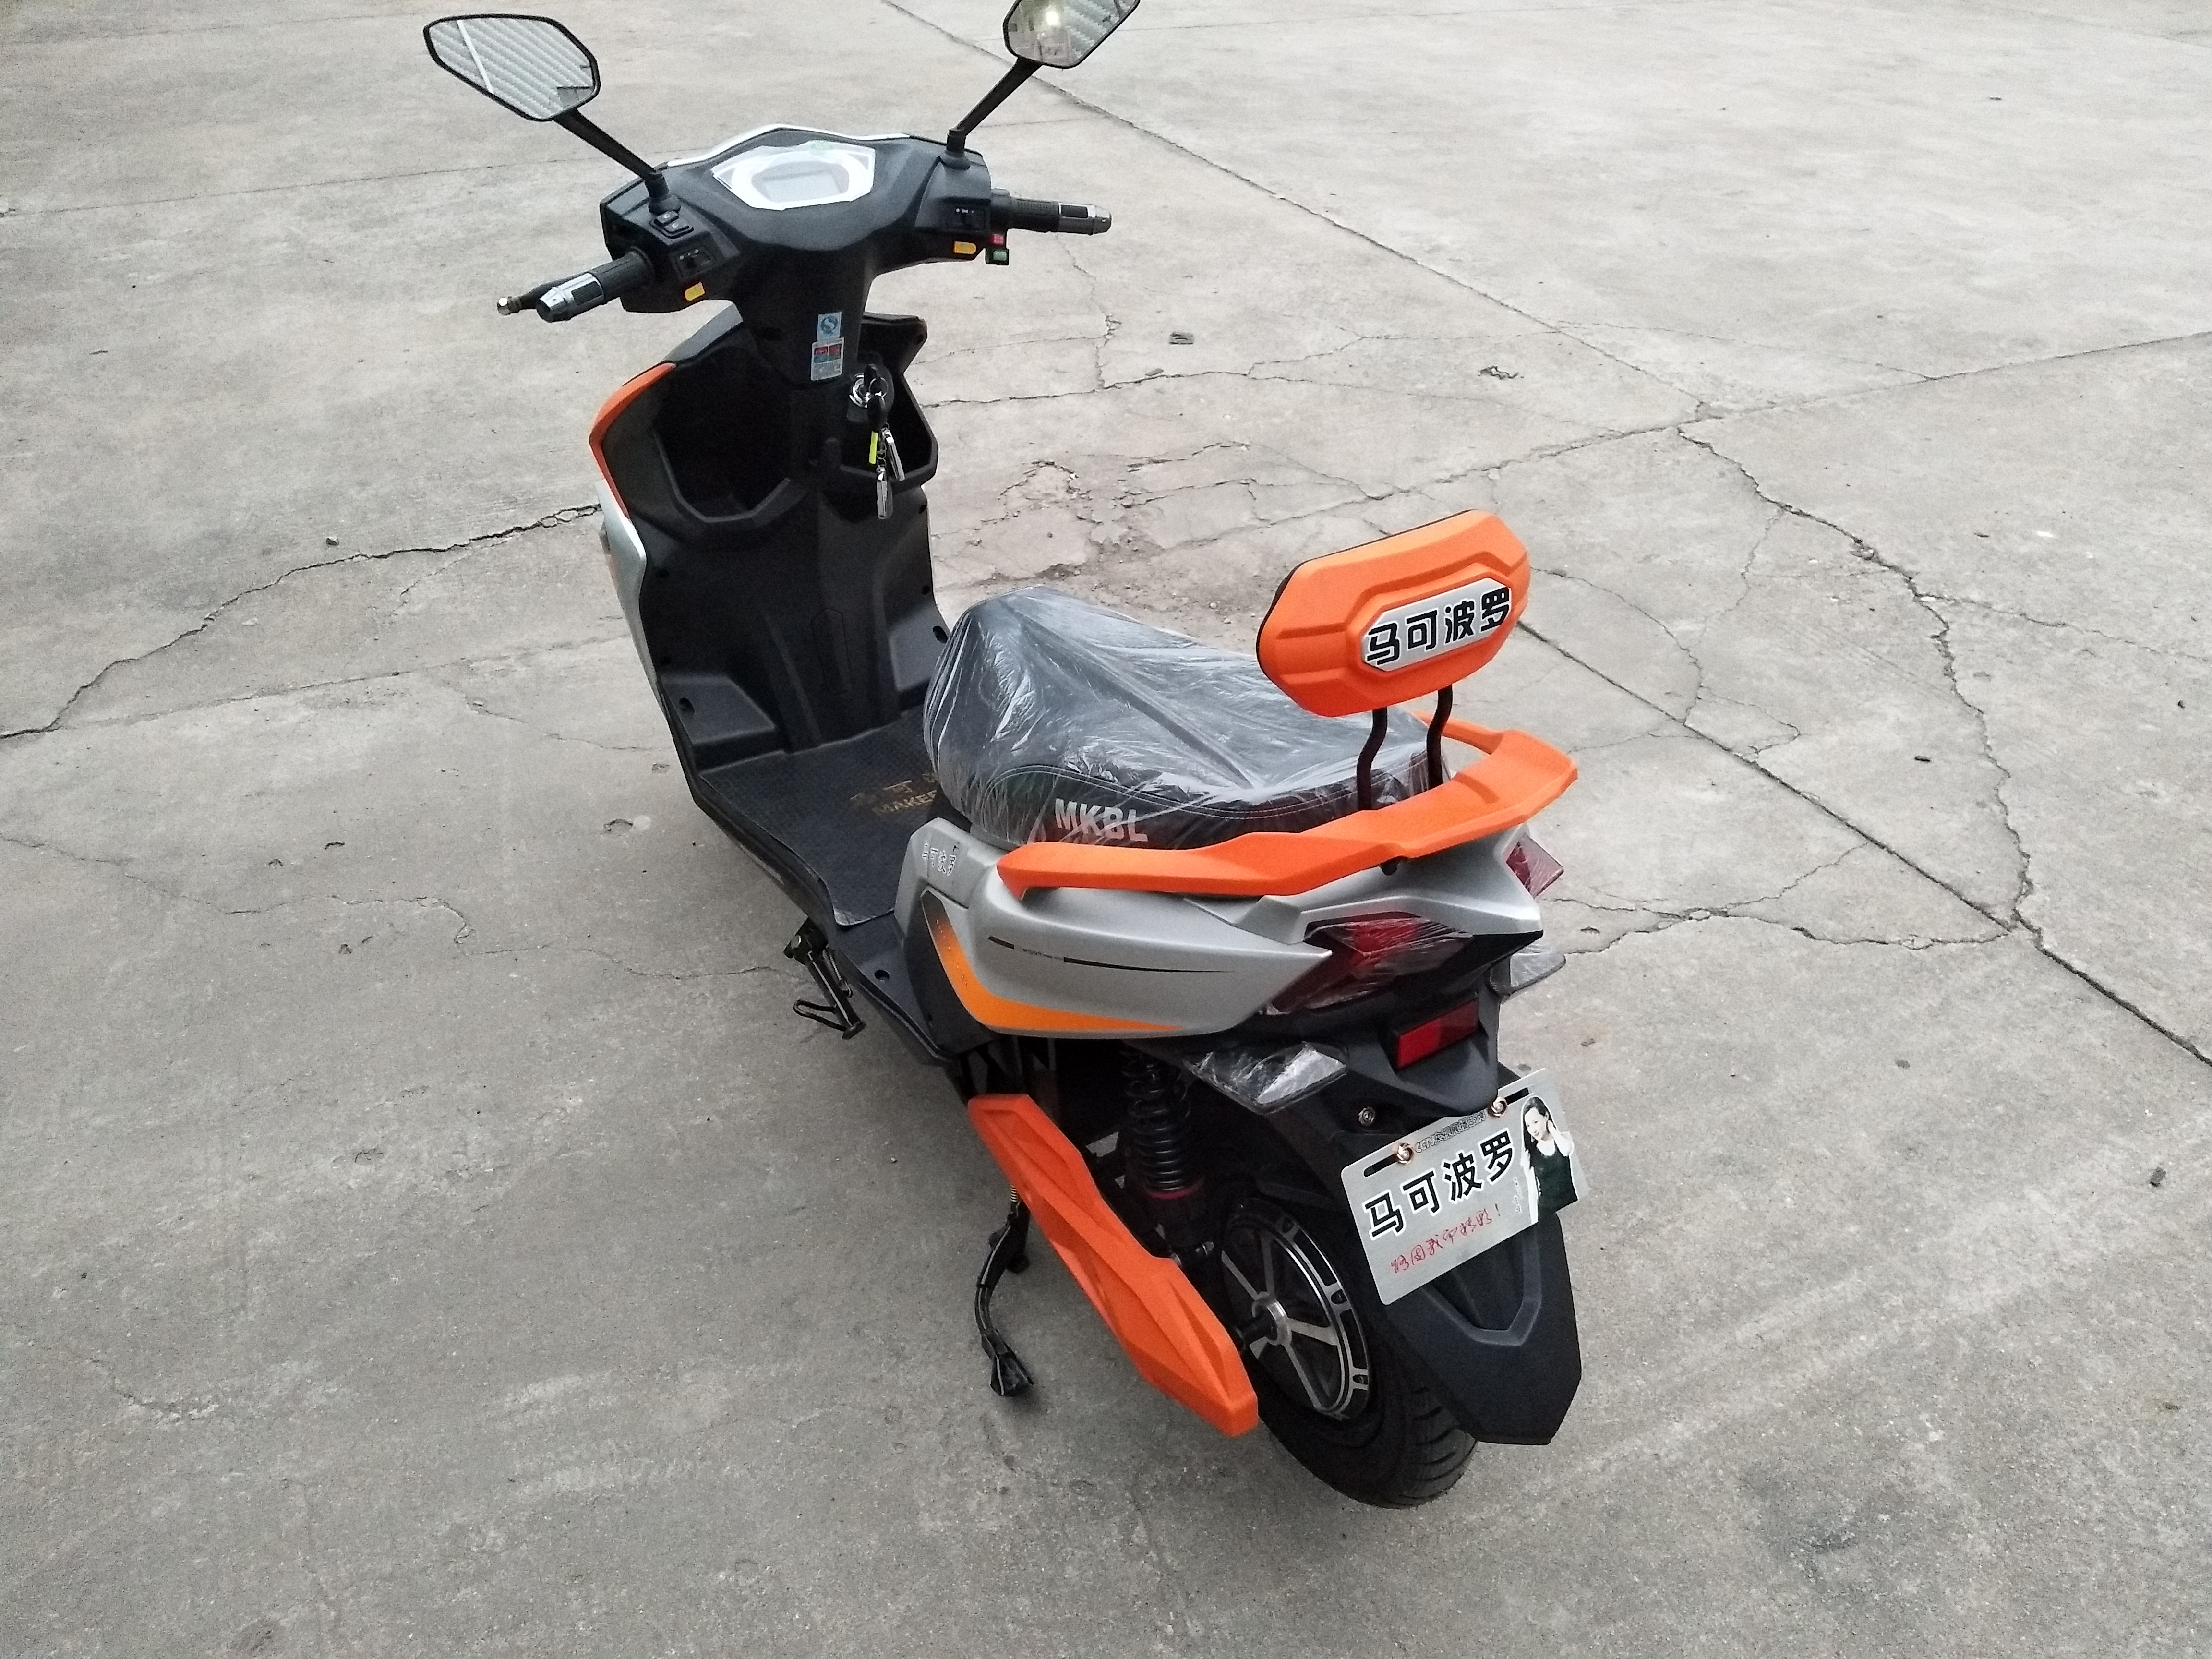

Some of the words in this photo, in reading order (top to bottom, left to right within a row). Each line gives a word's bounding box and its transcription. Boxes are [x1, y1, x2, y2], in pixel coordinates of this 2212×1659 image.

[1366, 587, 1509, 665] 马可波罗
[1055, 798, 1148, 842] MKBL
[1364, 1129, 1514, 1238] 马可波罗
